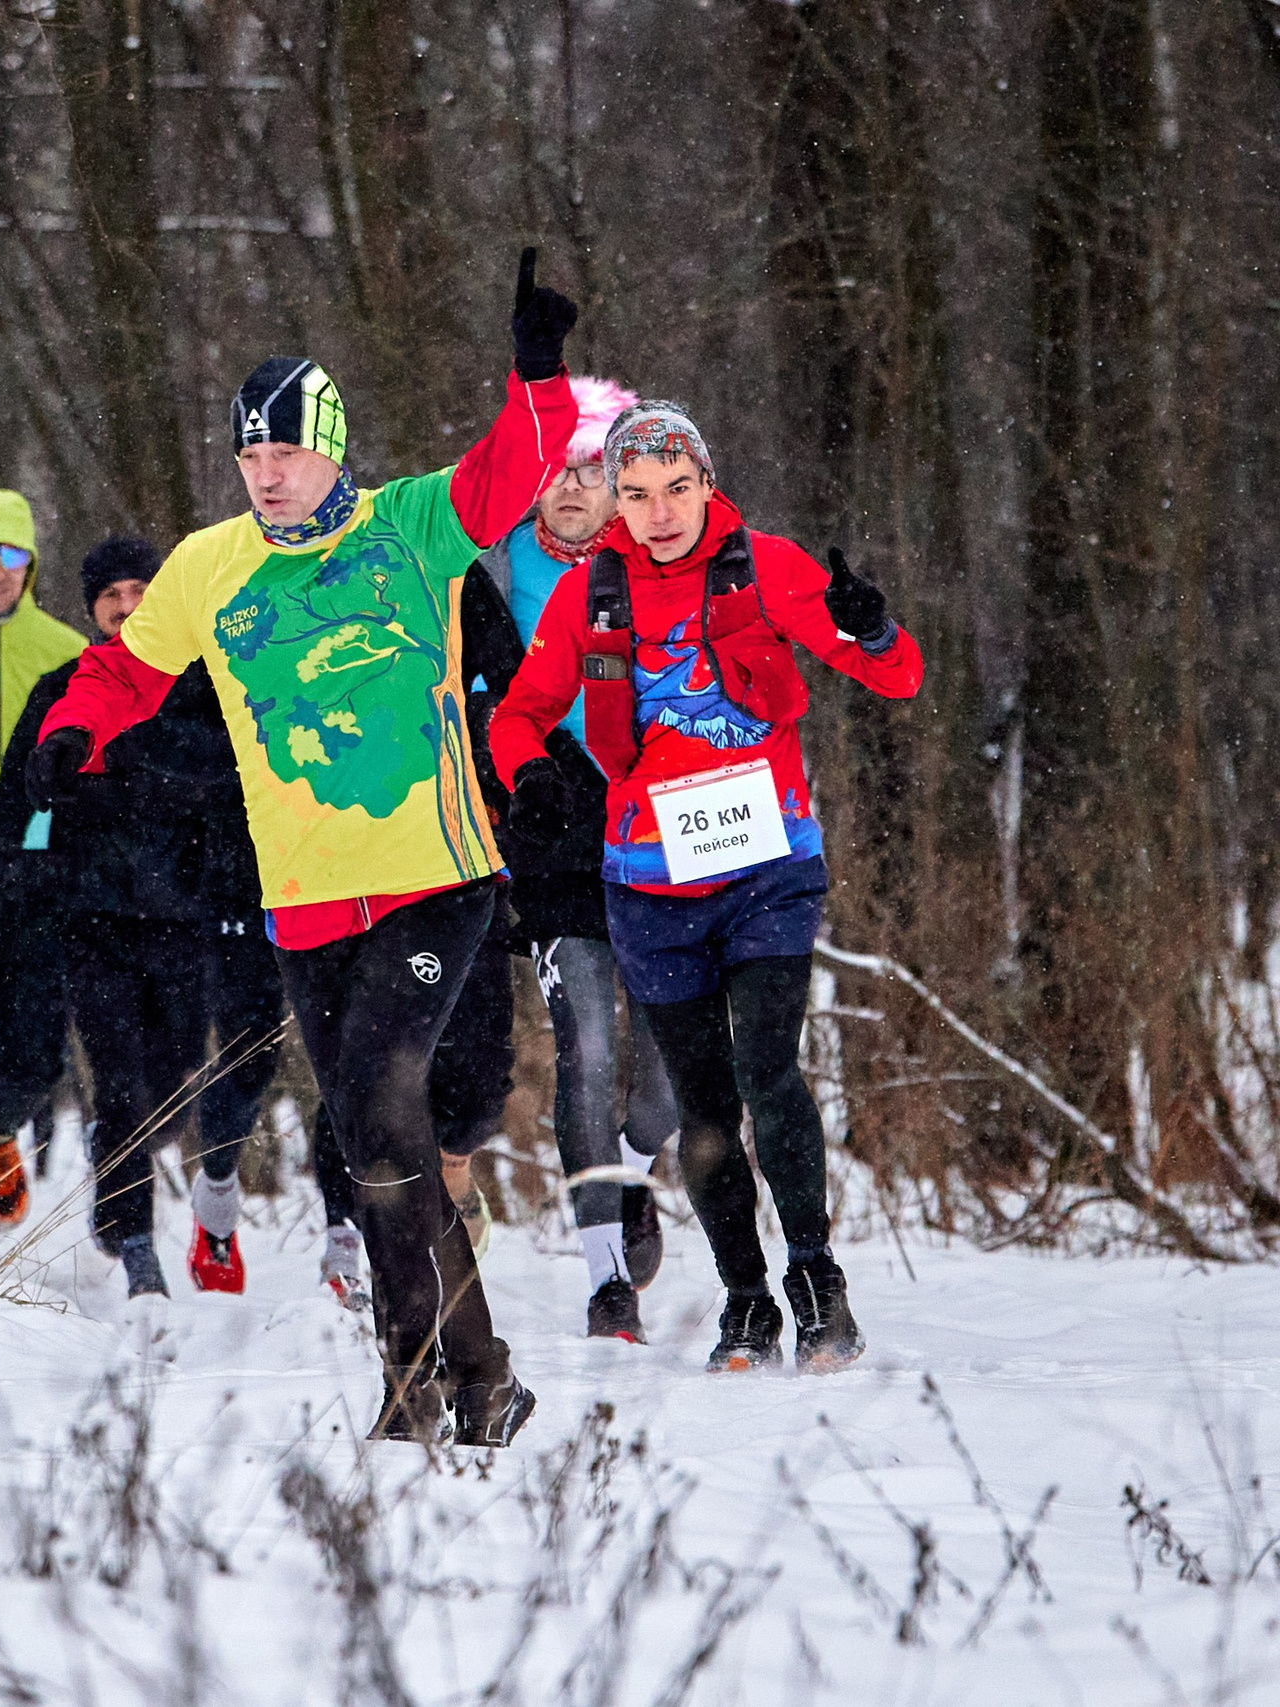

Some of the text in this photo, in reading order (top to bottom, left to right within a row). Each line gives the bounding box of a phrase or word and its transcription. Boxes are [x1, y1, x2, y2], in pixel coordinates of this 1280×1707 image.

[220, 605, 258, 630] BLIZKO
[224, 620, 255, 640] TRAIL
[677, 803, 751, 836] 26 км
[693, 832, 749, 855] пейсер
